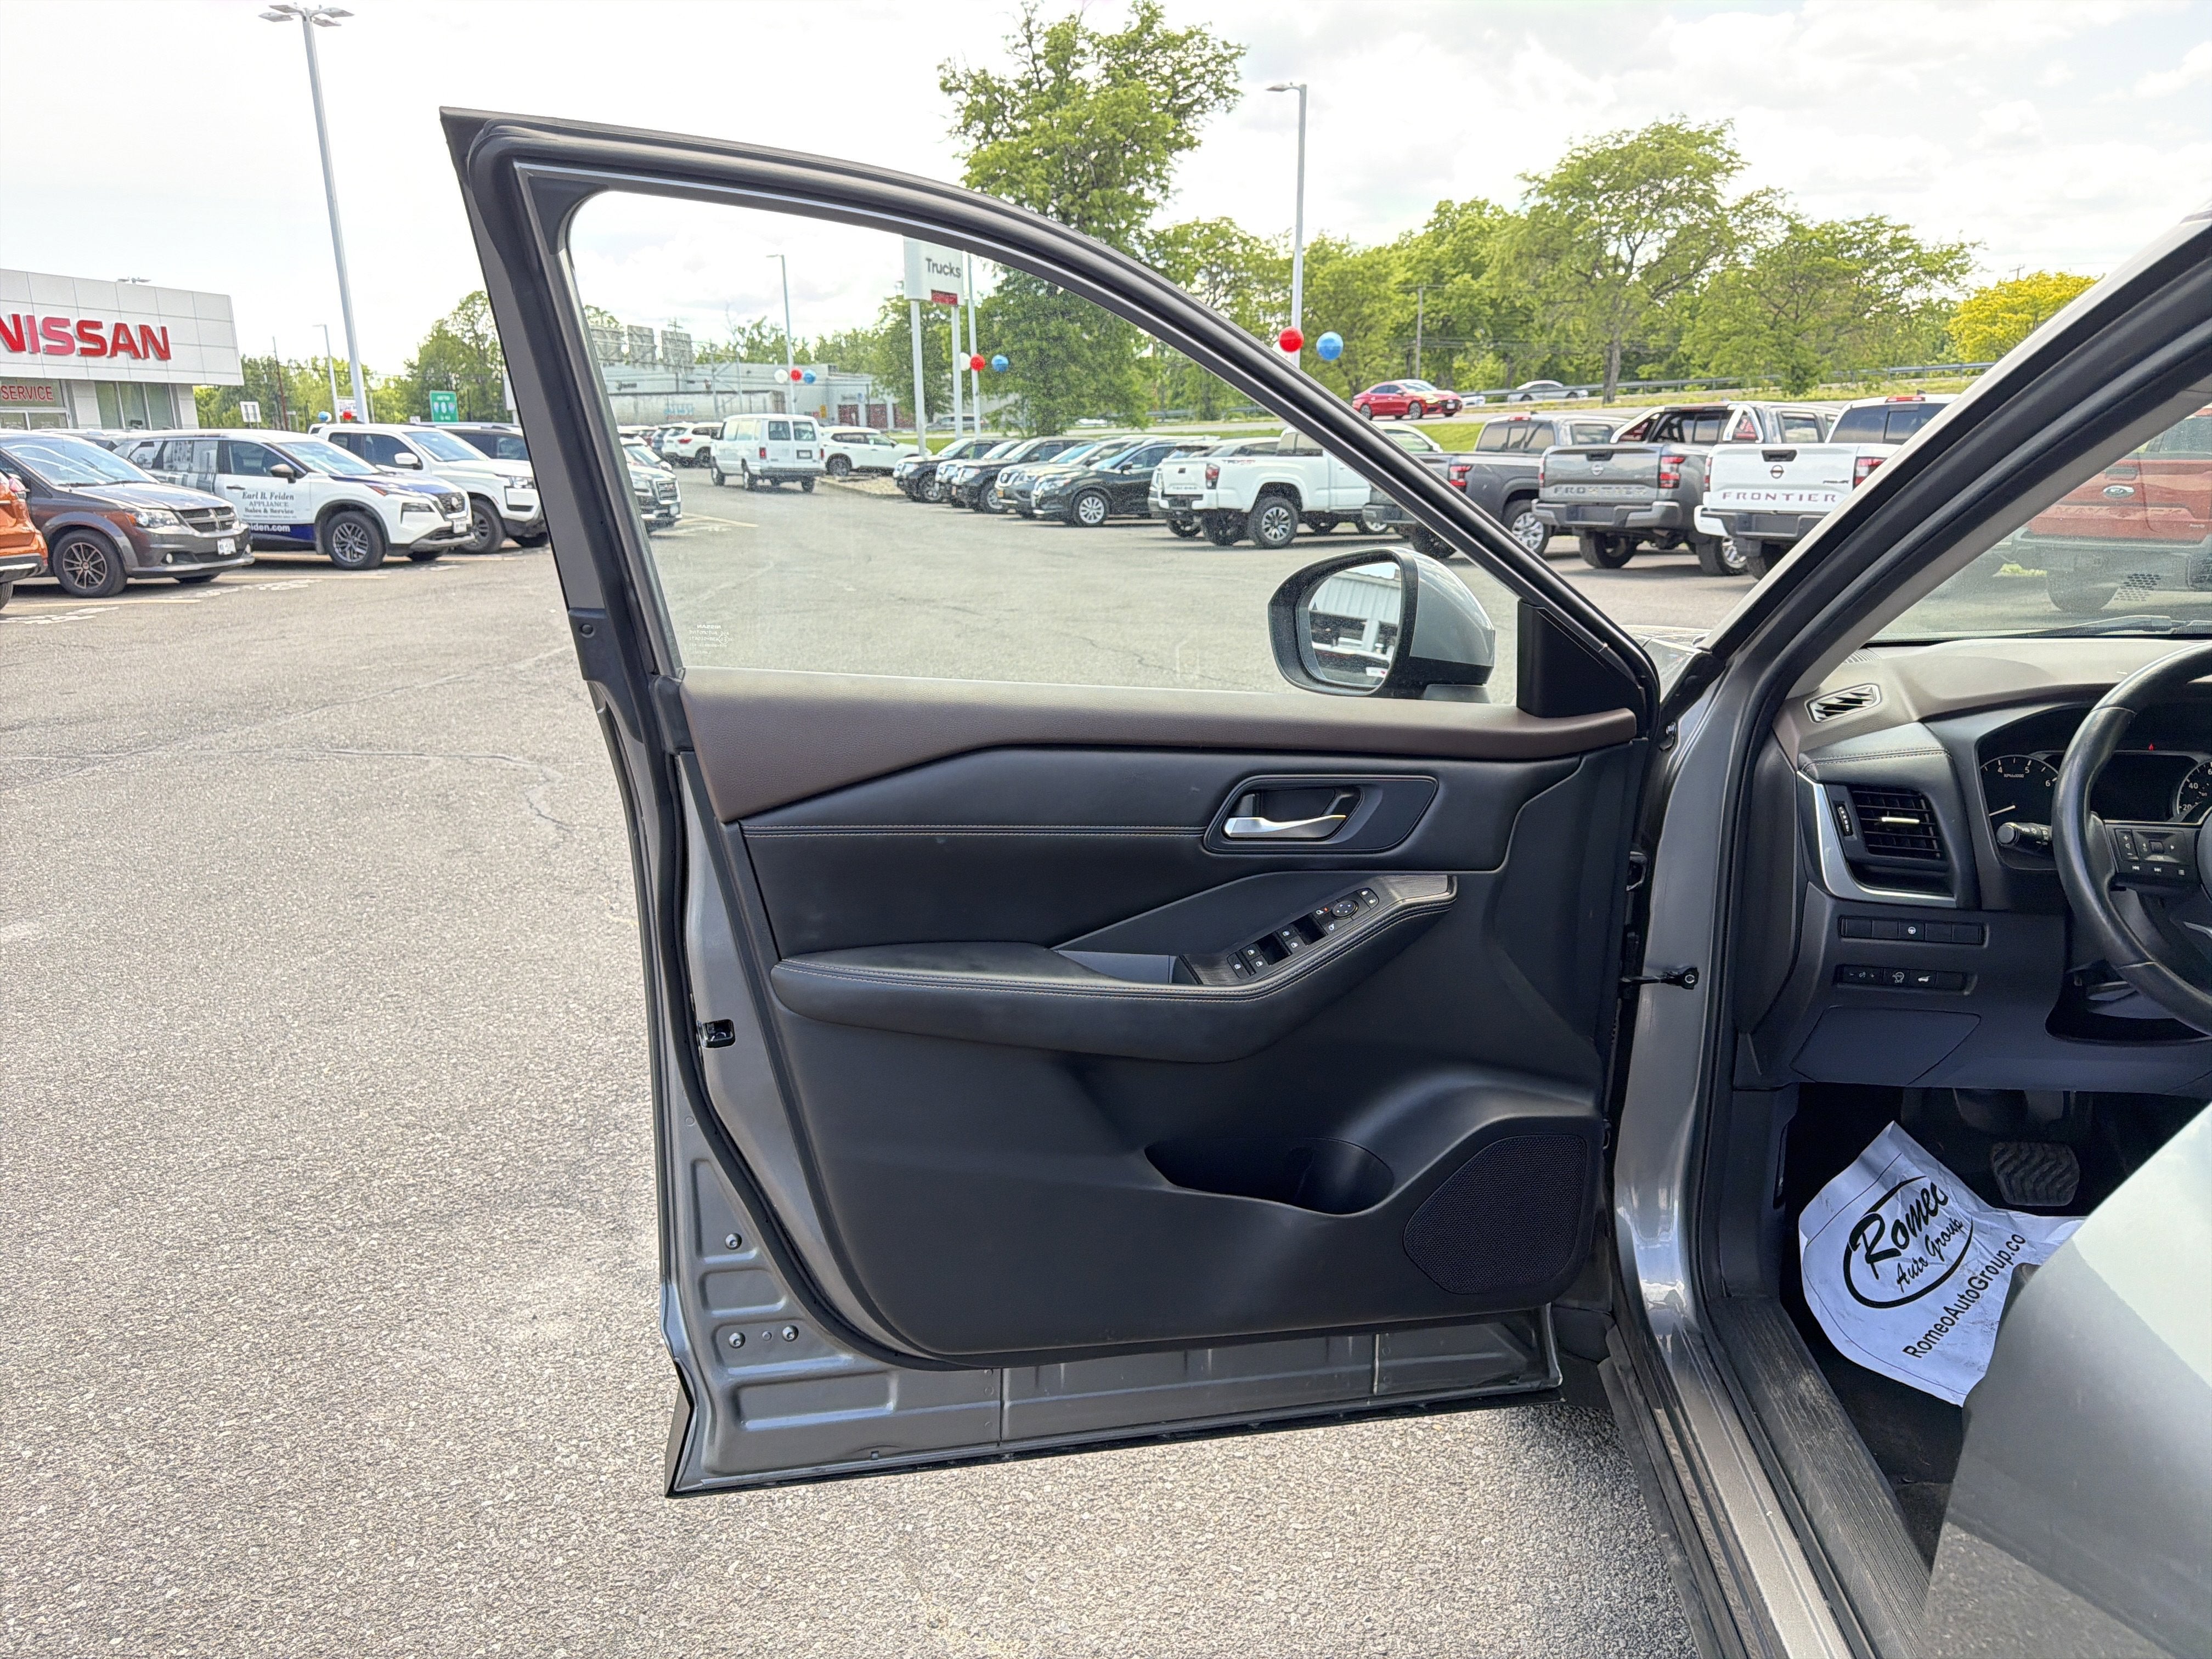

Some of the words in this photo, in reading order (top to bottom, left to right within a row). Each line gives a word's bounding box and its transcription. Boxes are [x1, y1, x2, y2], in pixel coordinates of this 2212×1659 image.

[925, 257, 961, 279] Trucks
[0, 313, 172, 360] NISSAN
[1, 385, 54, 401] SERVICE
[242, 492, 258, 500] Earl
[270, 492, 294, 500] Feiden
[1722, 492, 1836, 503] FRONTIER
[1896, 1256, 1929, 1294] Auto
[1925, 1217, 1963, 1262] Group
[1901, 1233, 2027, 1359] RomeoAutoGroup.co
